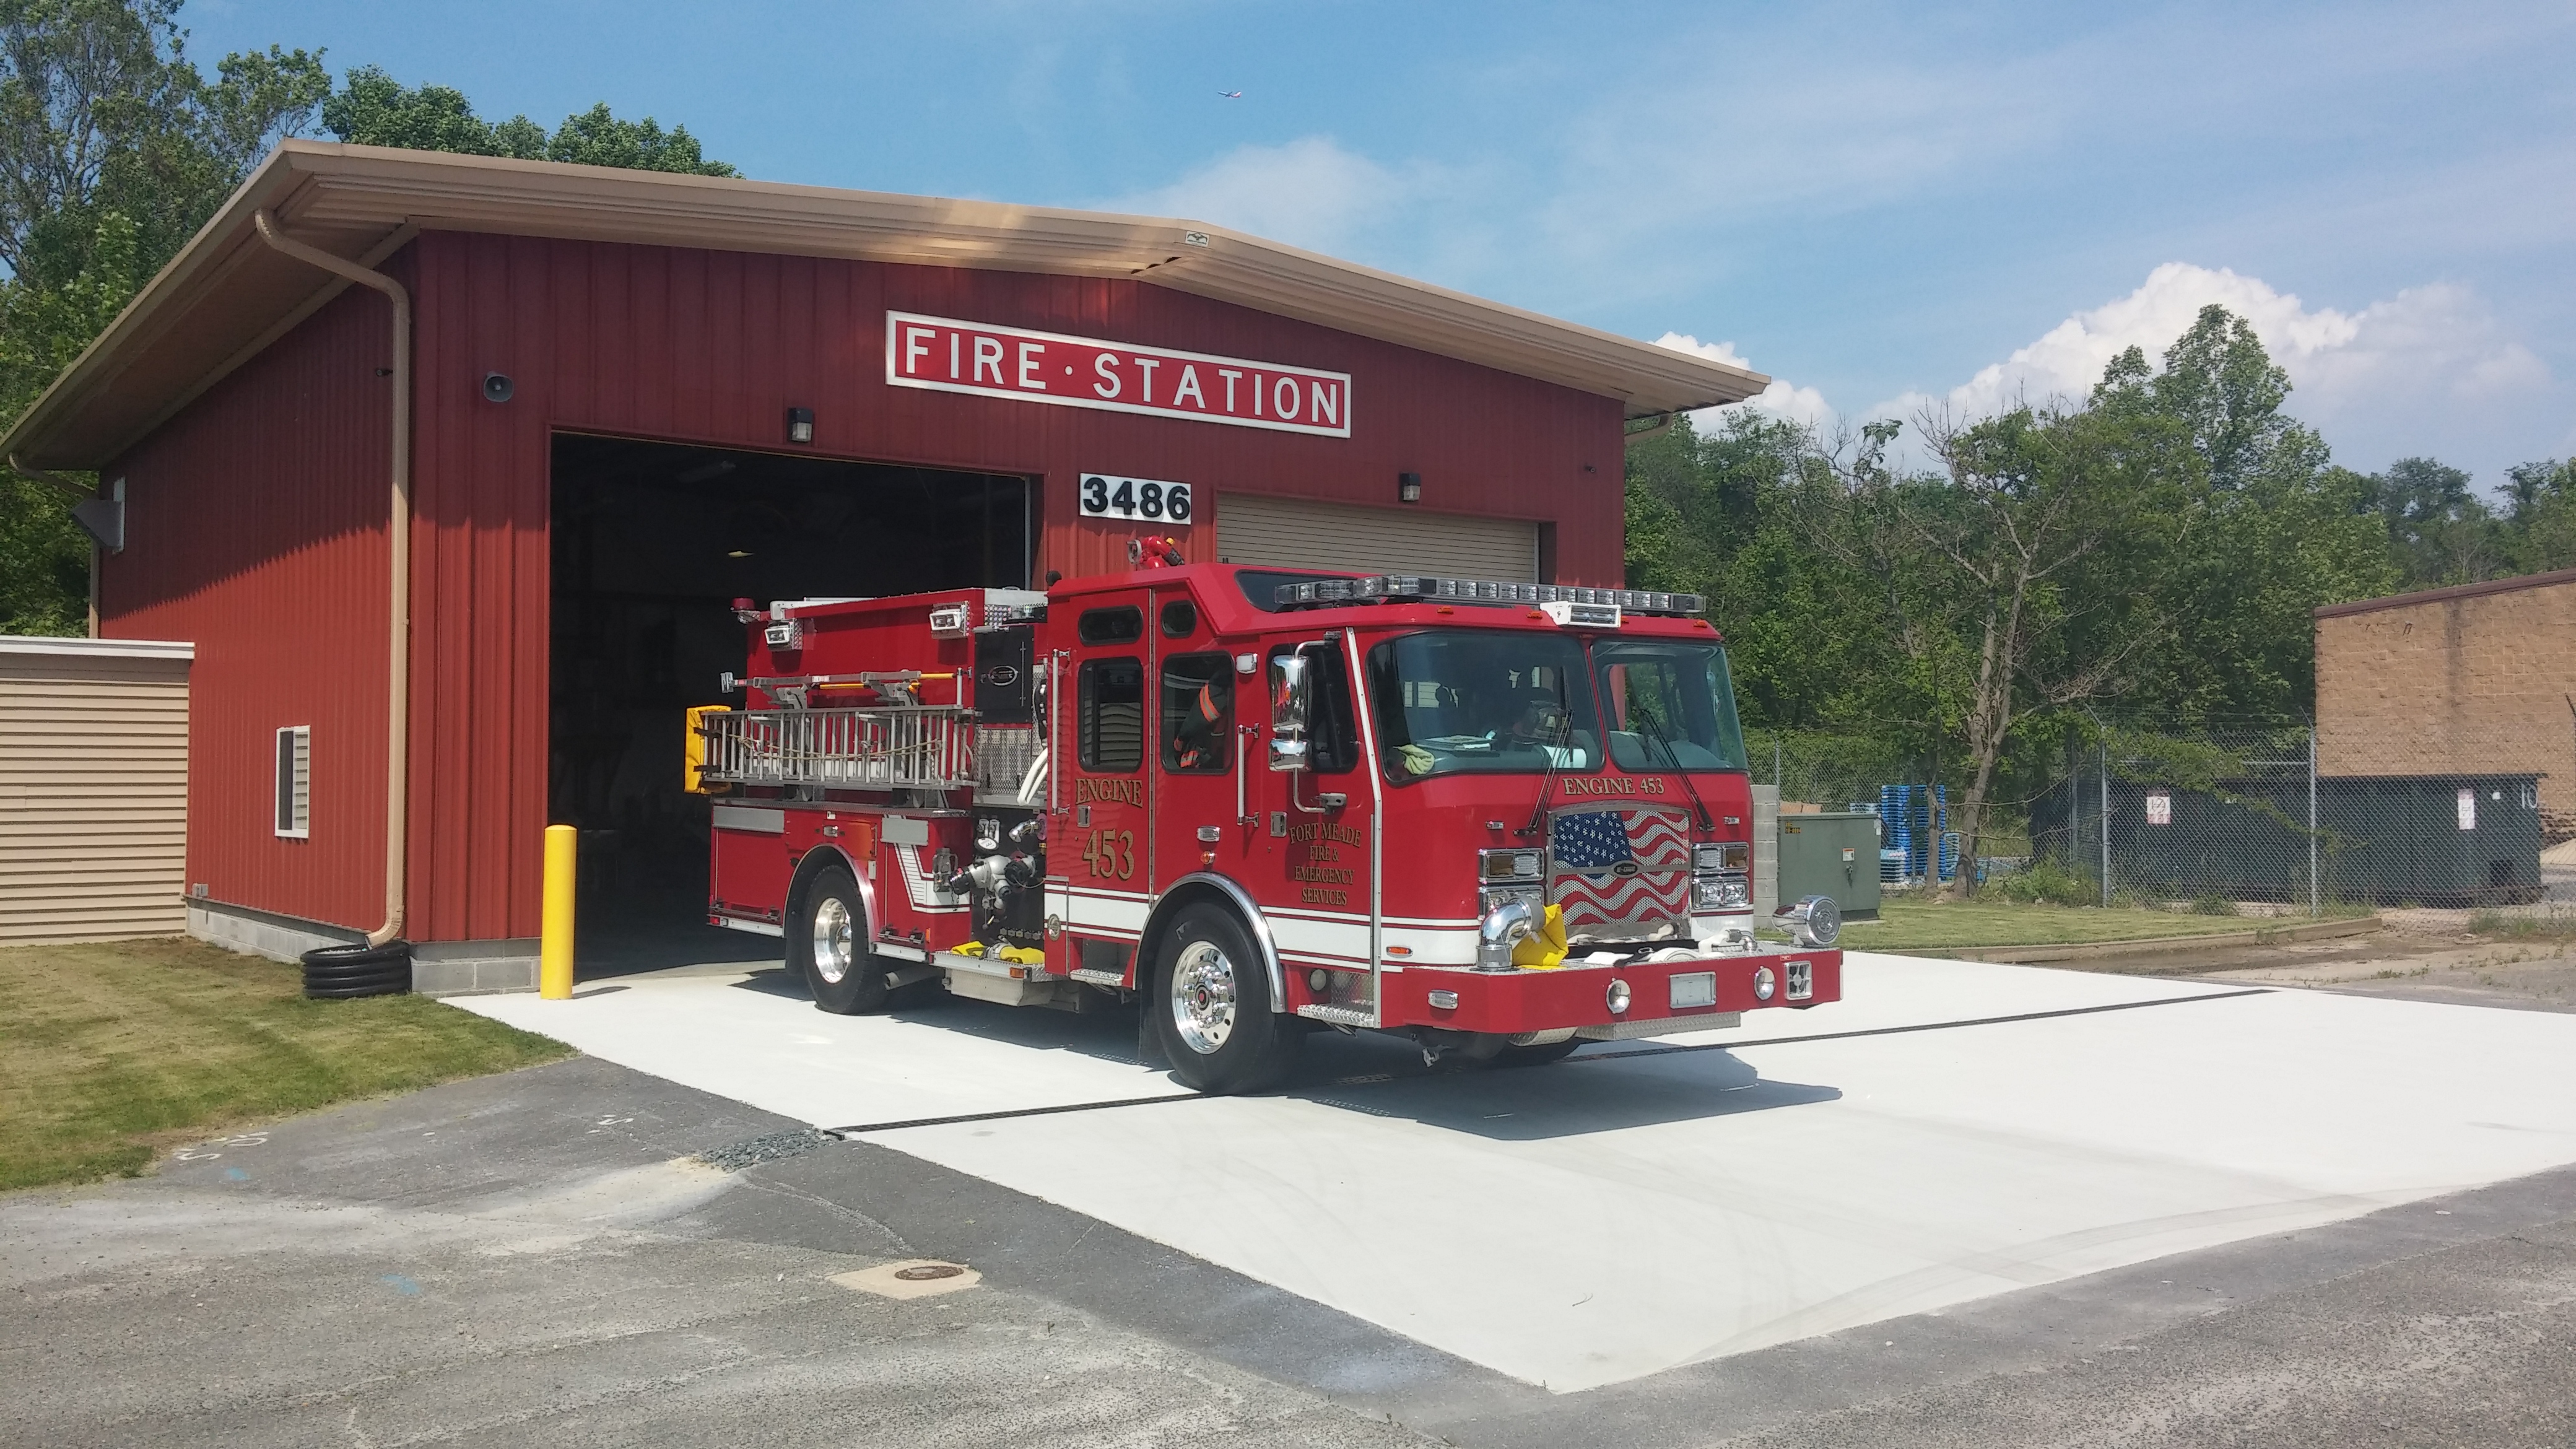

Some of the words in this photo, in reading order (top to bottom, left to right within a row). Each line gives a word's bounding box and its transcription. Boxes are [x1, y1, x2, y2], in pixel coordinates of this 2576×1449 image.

[905, 326, 1047, 390] FIRE
[1093, 352, 1338, 425] STATION
[1083, 477, 1190, 520] 3486
[1076, 778, 1144, 808] ENGINE
[1562, 777, 1636, 795] ENGINE
[1640, 777, 1665, 794] 453
[1289, 822, 1320, 845] FORT
[1321, 822, 1362, 848] MEADE
[1082, 828, 1135, 881] 453
[1309, 845, 1331, 861] FIRE
[1332, 846, 1339, 861] &
[1295, 866, 1355, 885] EMERGENCY
[1302, 887, 1347, 906] SERVICES
